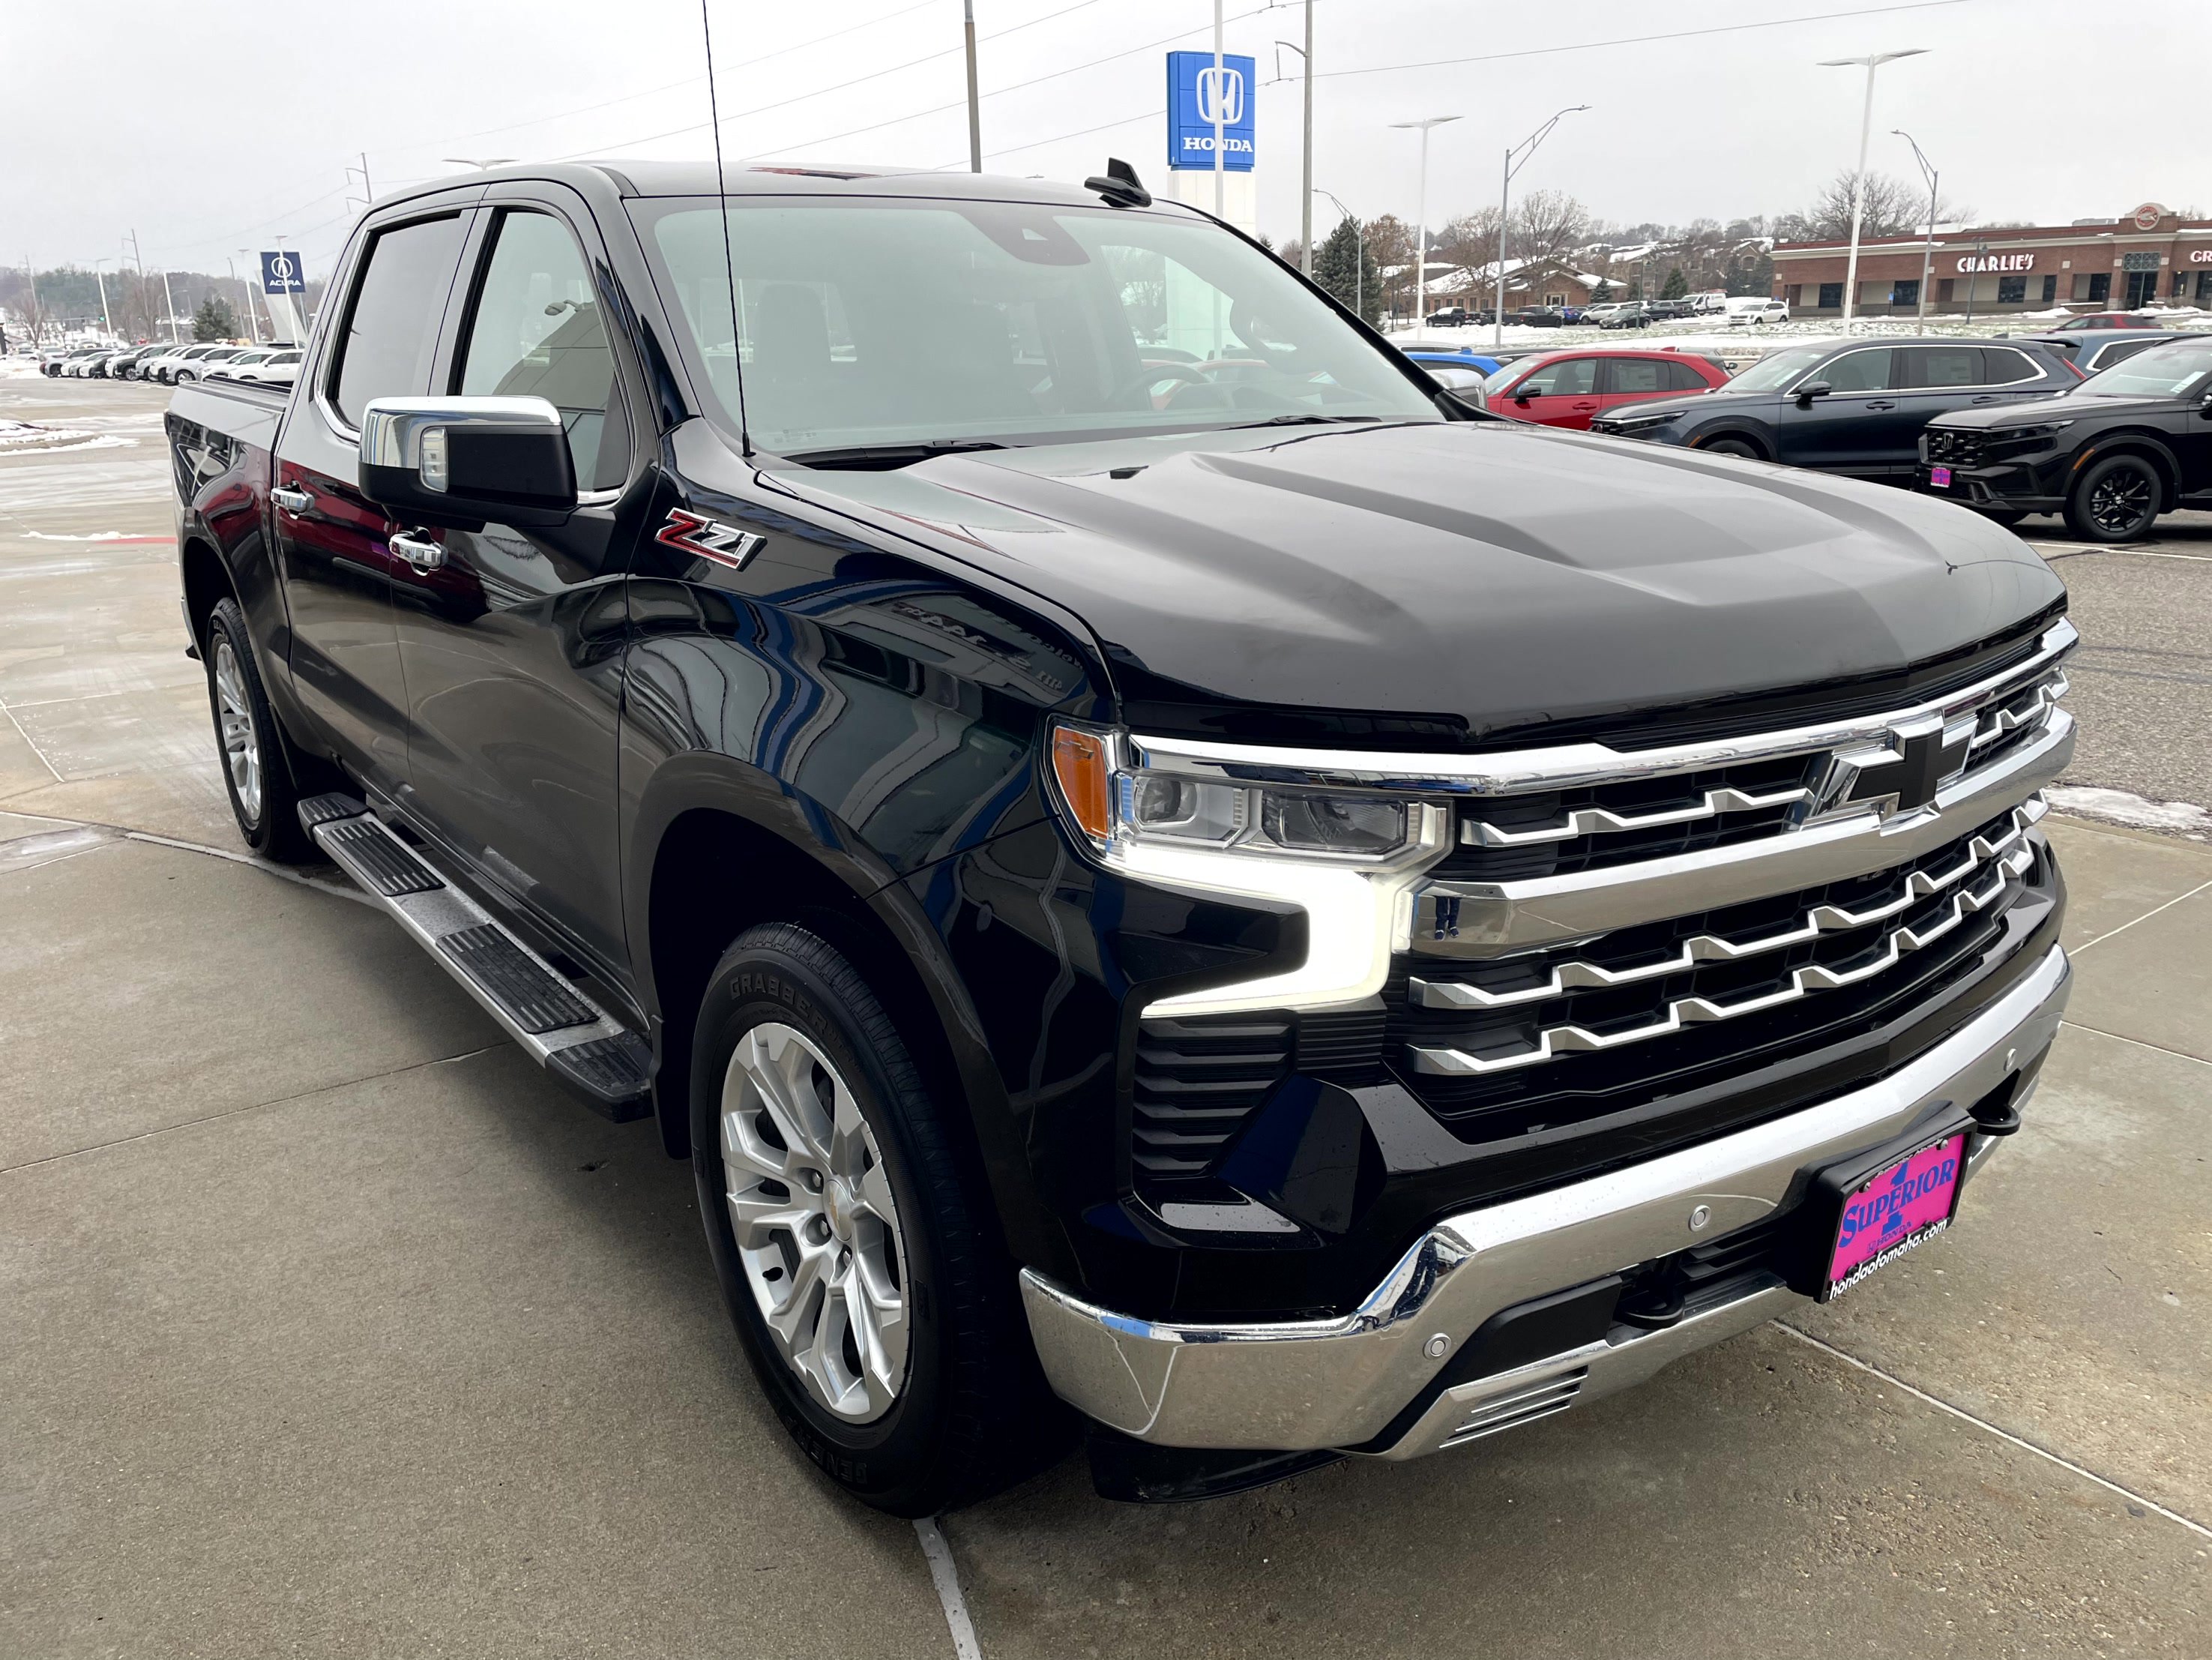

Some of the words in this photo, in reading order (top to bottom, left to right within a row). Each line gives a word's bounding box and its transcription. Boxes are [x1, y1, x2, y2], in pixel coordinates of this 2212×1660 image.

[1957, 253, 2034, 273] CHARLIE'S
[654, 507, 765, 570] Z71
[730, 972, 829, 1035] GRABBER
[1838, 1158, 1956, 1248] SUPERIOR
[1830, 1219, 1947, 1300] hondaofomaha.com
